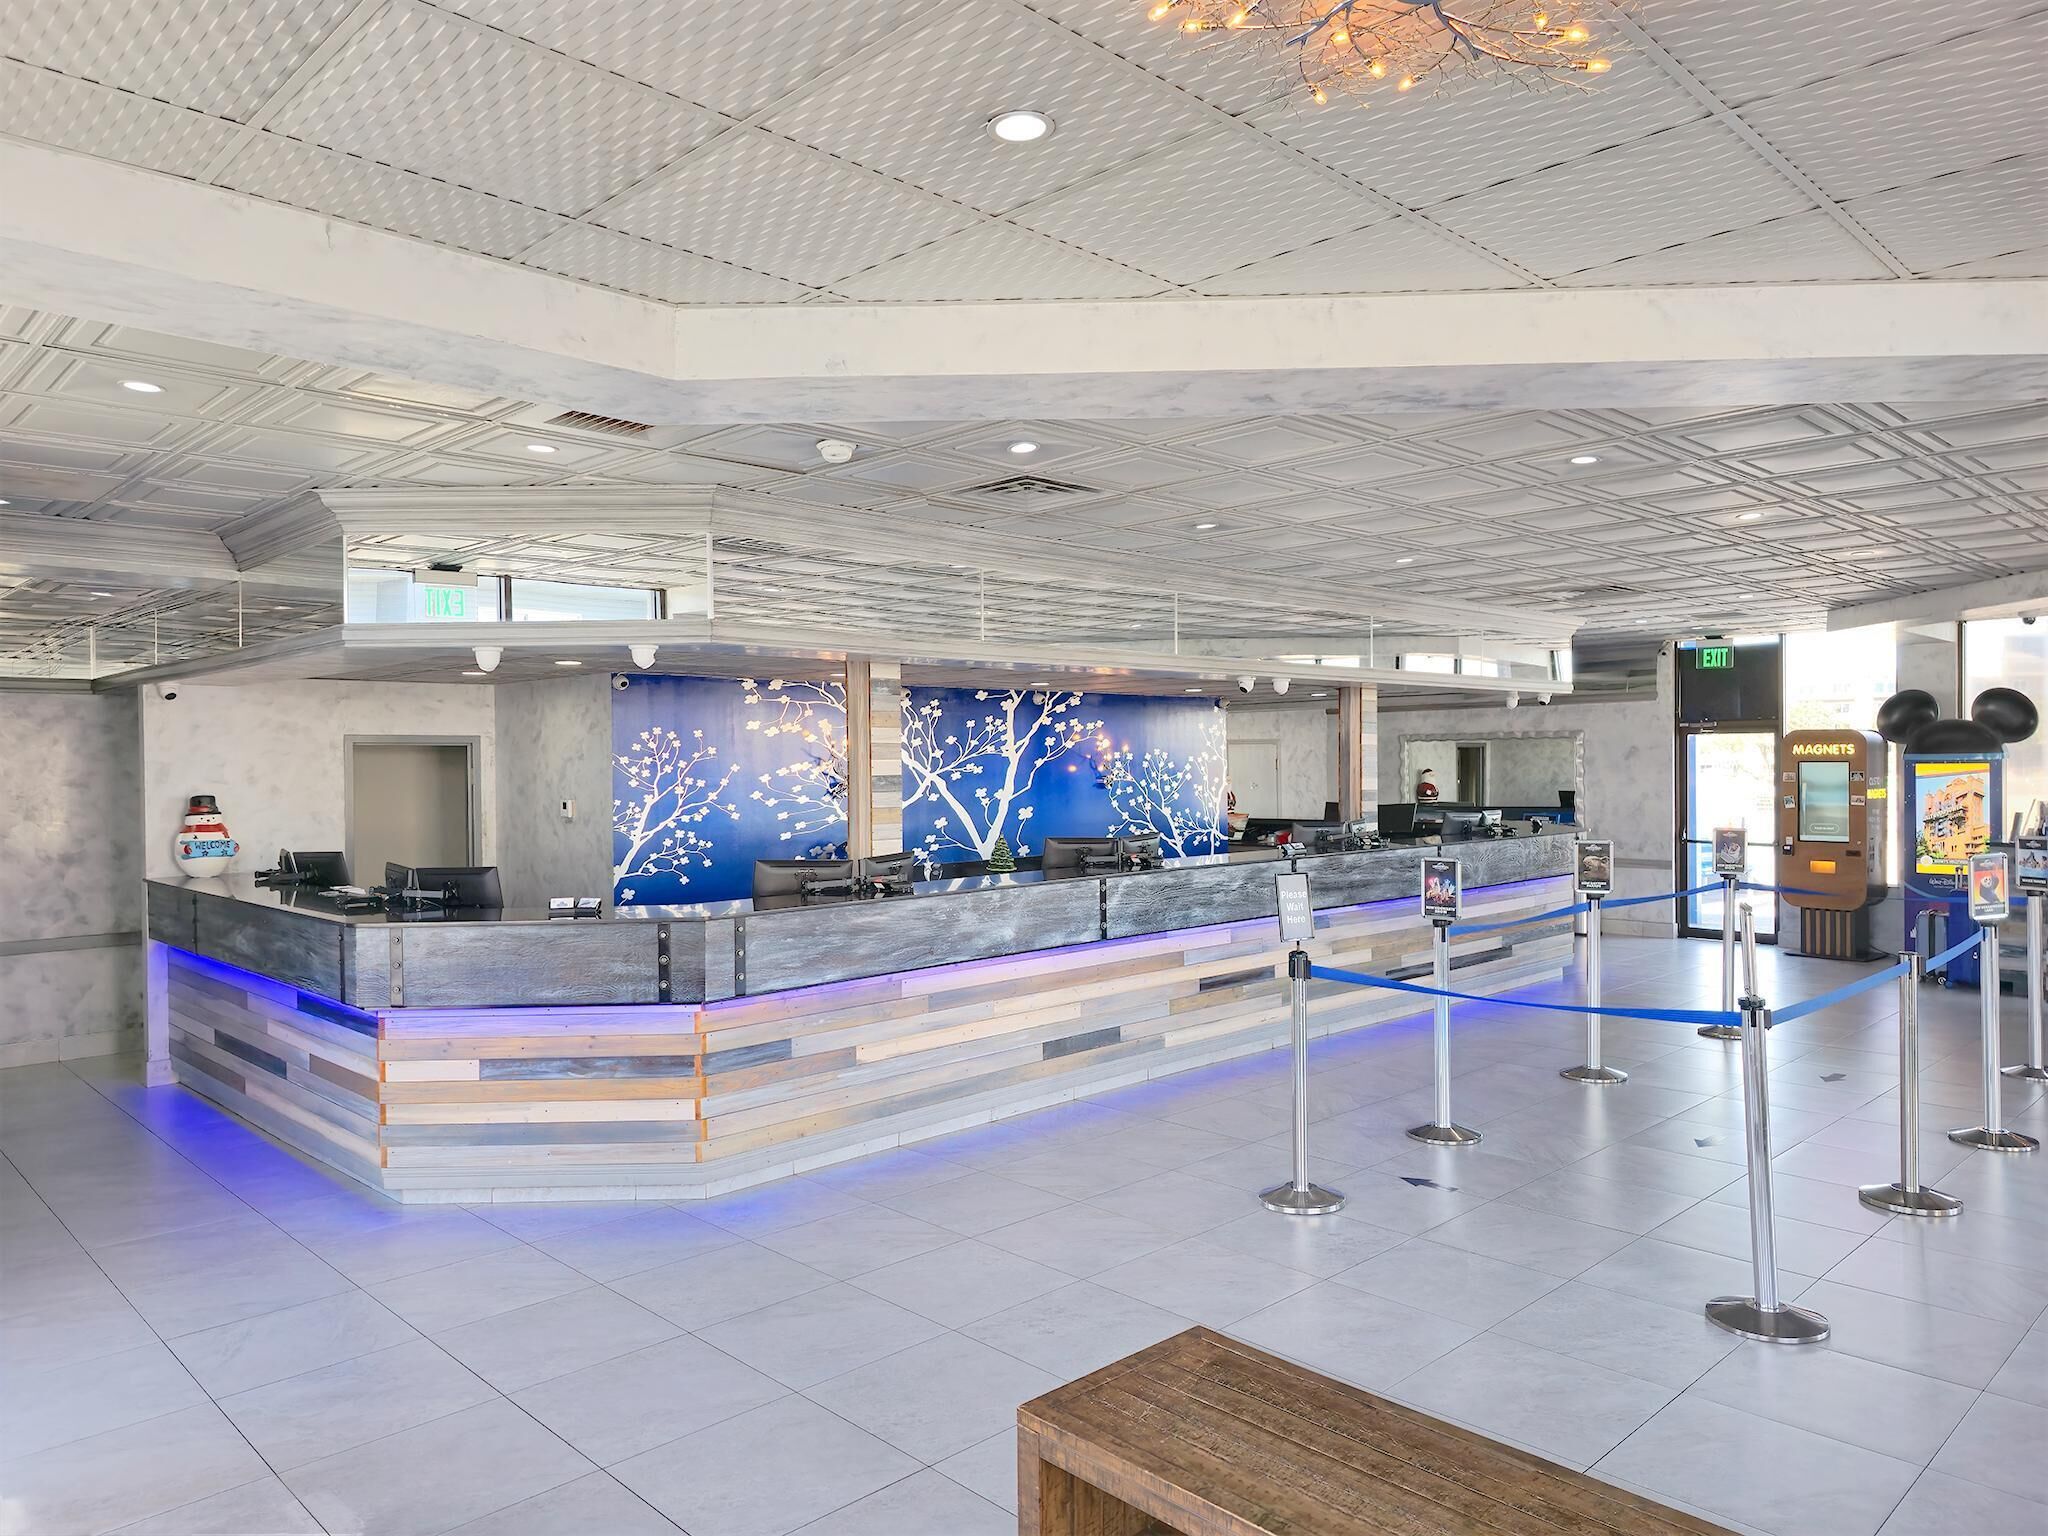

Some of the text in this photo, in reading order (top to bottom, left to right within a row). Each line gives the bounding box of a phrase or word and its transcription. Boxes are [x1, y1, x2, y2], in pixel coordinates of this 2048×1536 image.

[1703, 647, 1728, 667] EXIT
[1792, 743, 1856, 755] MAGNETS
[194, 840, 231, 850] WELCOME
[1281, 890, 1307, 899] Please
[1286, 902, 1304, 911] Wait
[1286, 915, 1306, 924] Here
